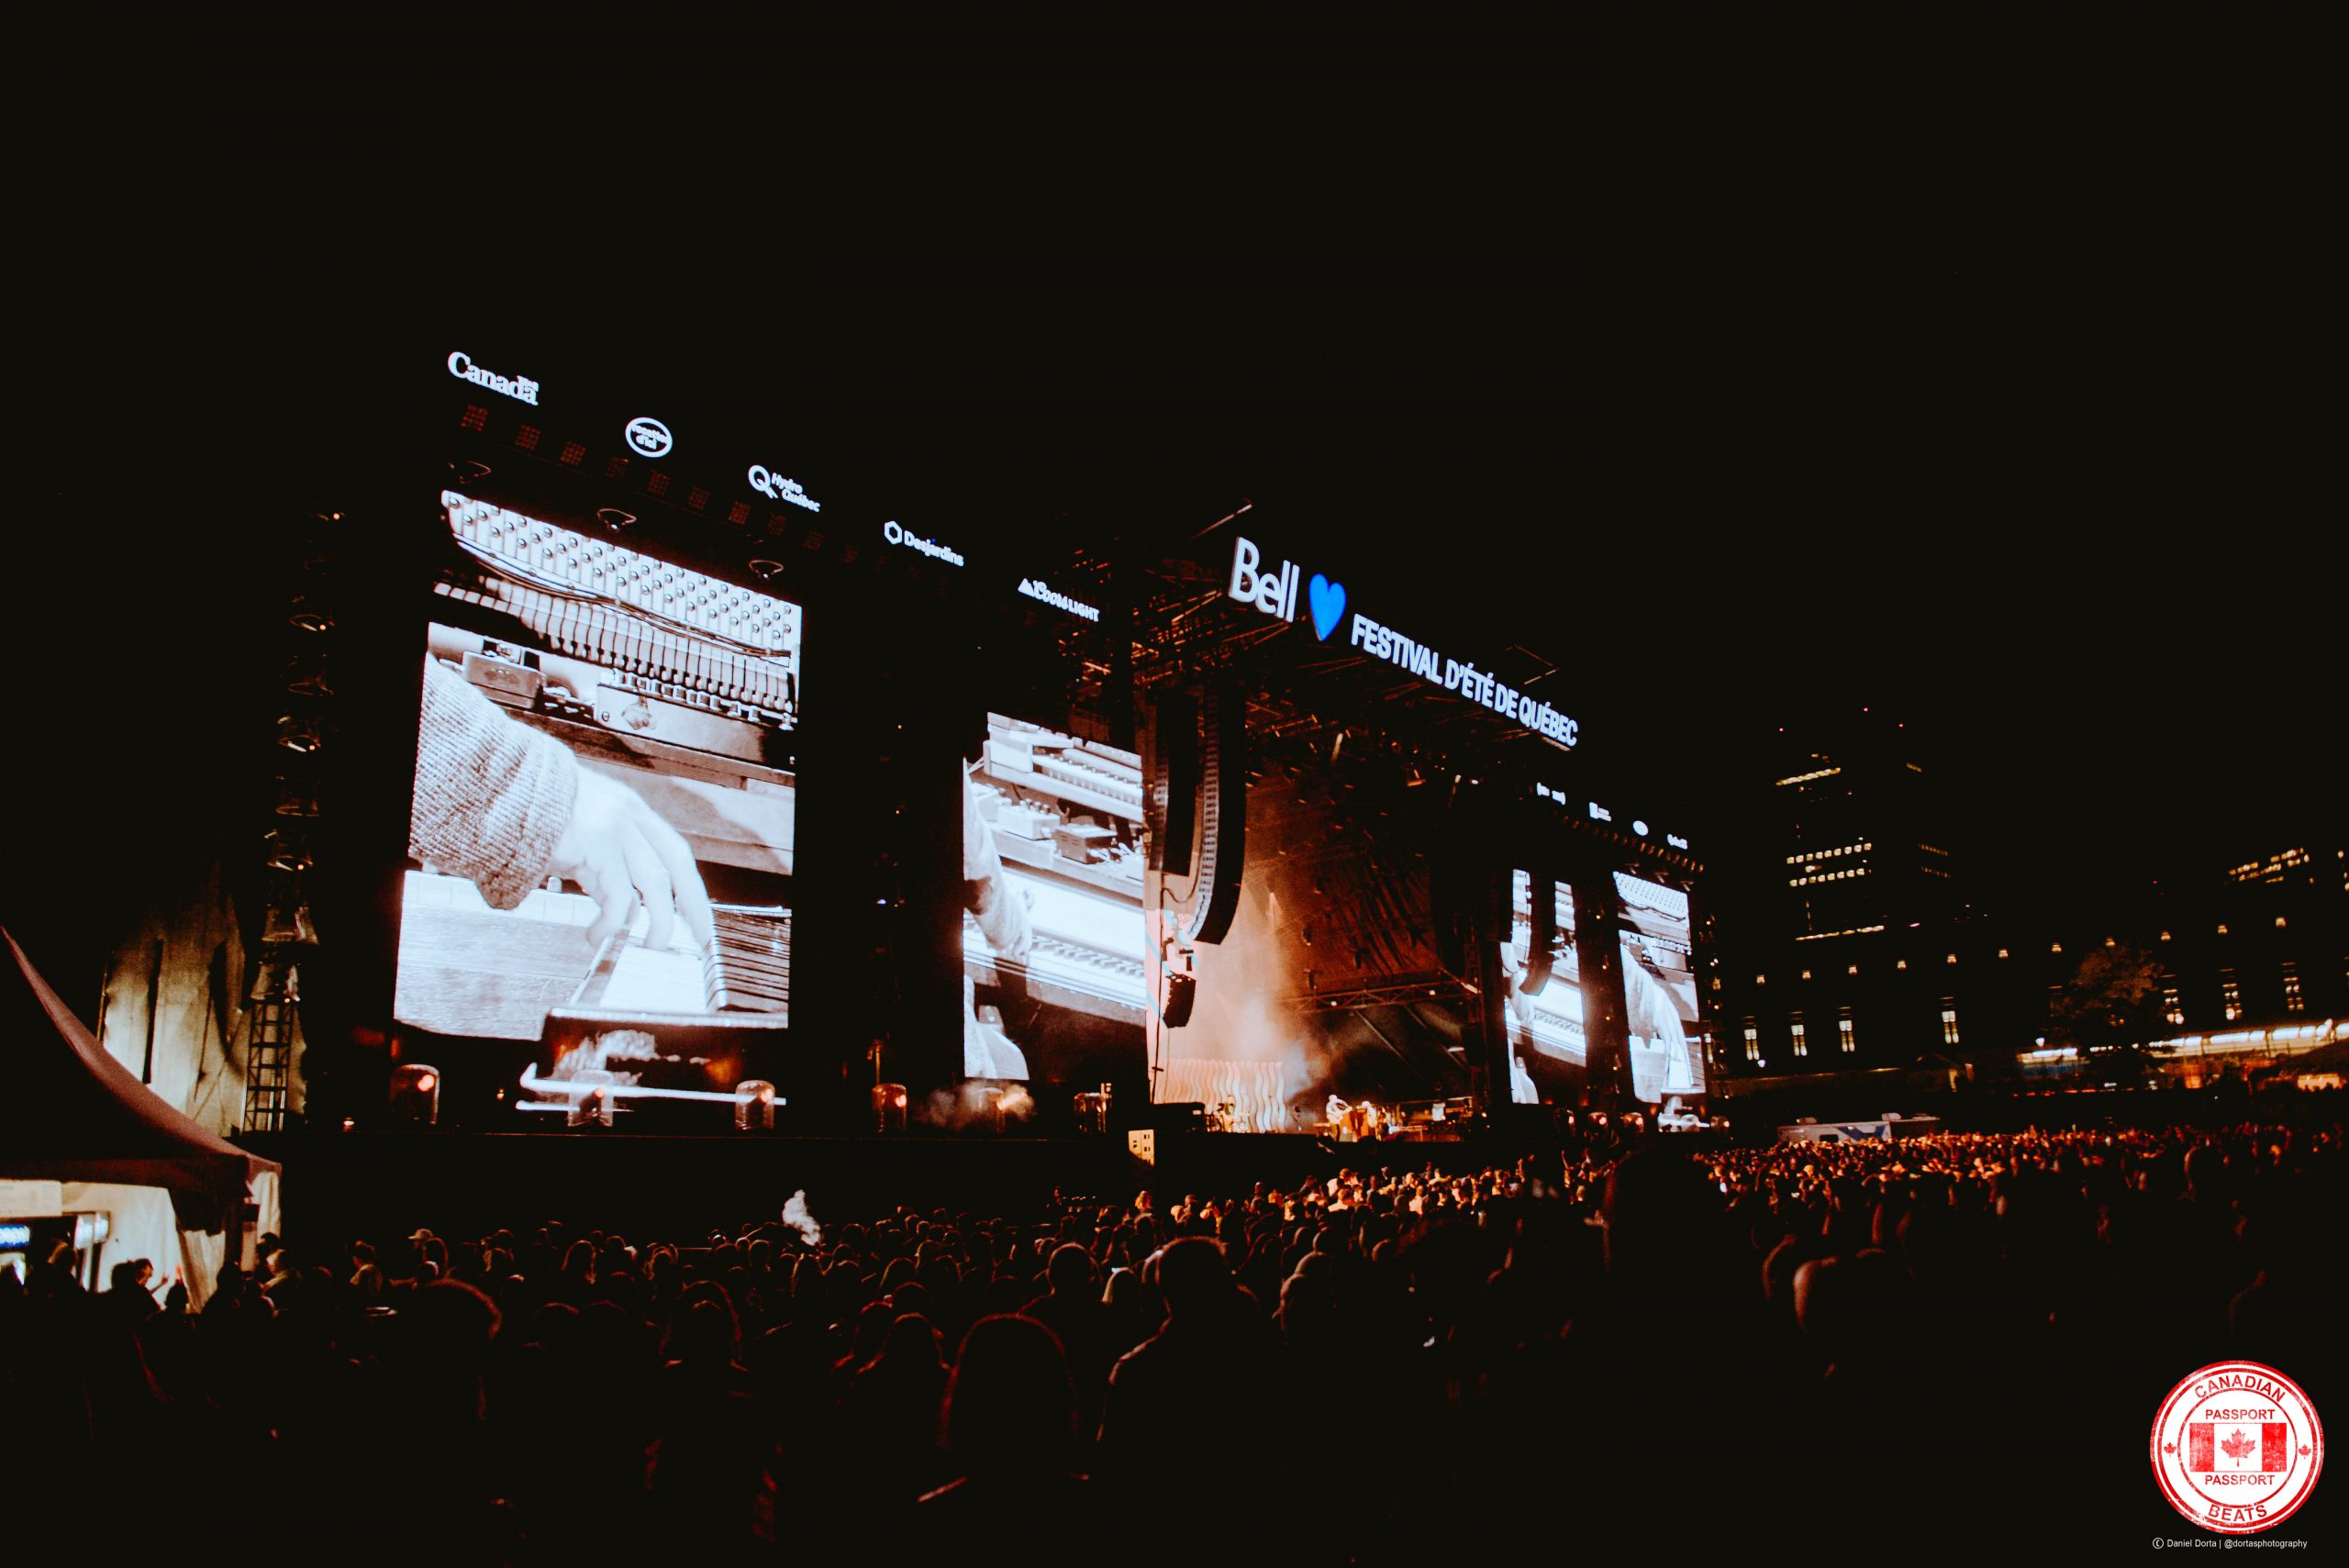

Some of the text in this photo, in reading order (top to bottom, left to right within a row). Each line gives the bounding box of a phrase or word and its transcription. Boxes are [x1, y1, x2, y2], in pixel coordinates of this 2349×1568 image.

[448, 351, 539, 406] Canada
[772, 473, 803, 494] Hydro
[782, 489, 819, 512] Québec
[904, 530, 963, 566] Desjardins
[1228, 536, 1300, 623] Bell
[1068, 598, 1098, 622] LIGHT
[1351, 612, 1579, 748] FESTIVAL D'ÉTÉ DE QUÉBEC
